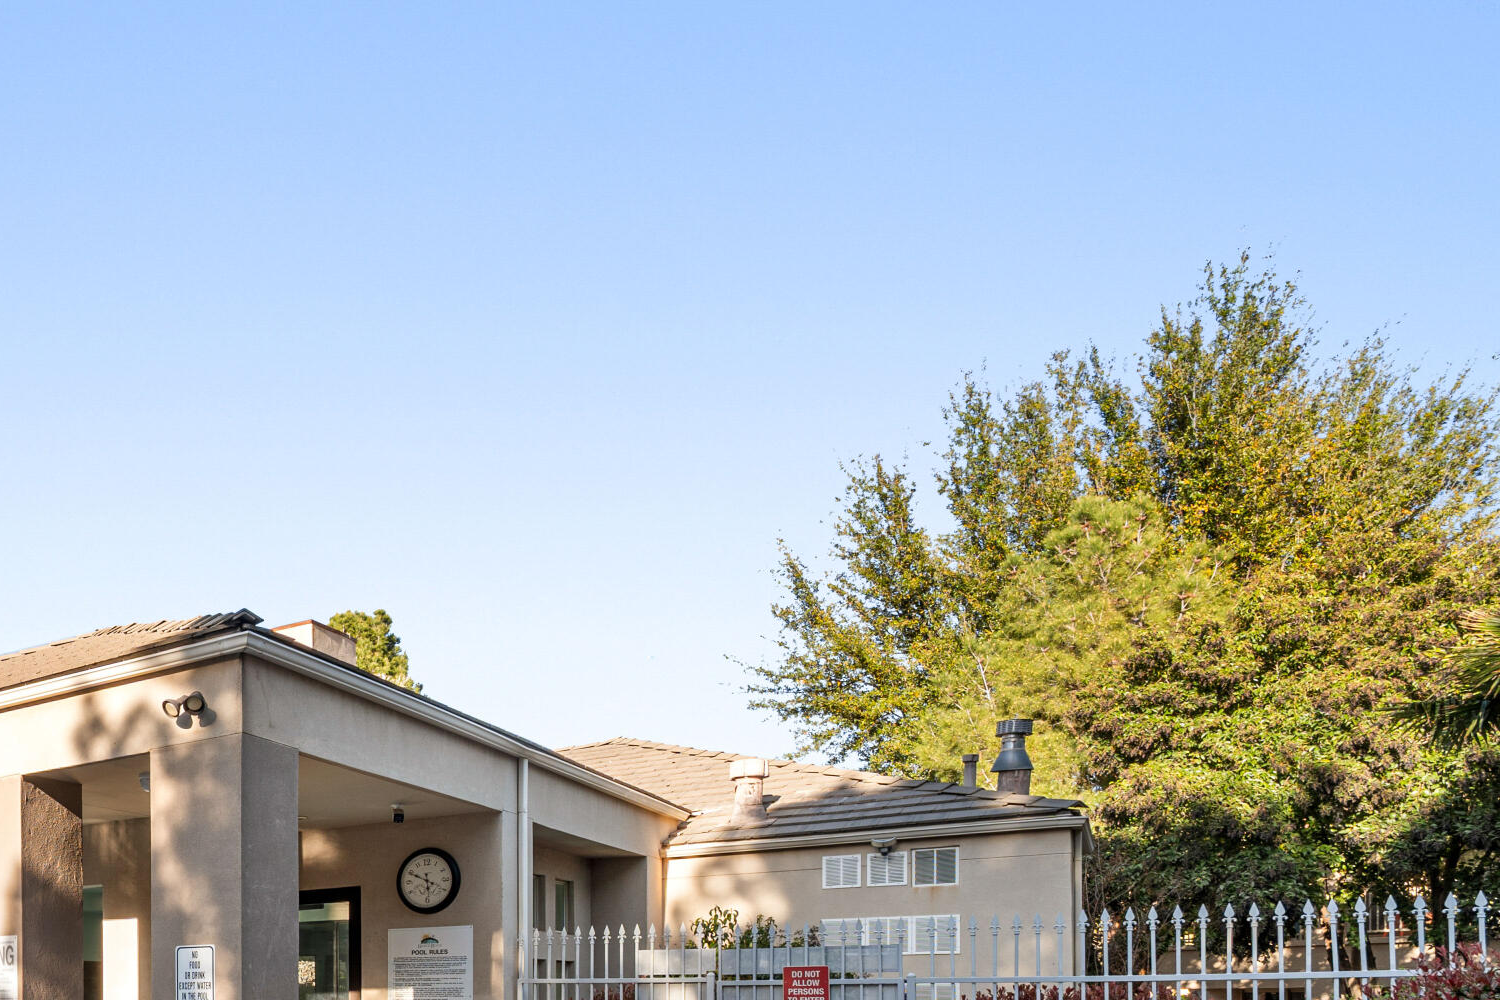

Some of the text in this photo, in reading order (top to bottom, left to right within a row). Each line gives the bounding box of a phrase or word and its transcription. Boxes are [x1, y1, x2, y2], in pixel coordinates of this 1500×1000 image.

[423, 858, 431, 866] 12
[189, 961, 200, 969] FOOD
[192, 971, 205, 979] DRINK
[179, 982, 211, 990] EXCEPT WATER
